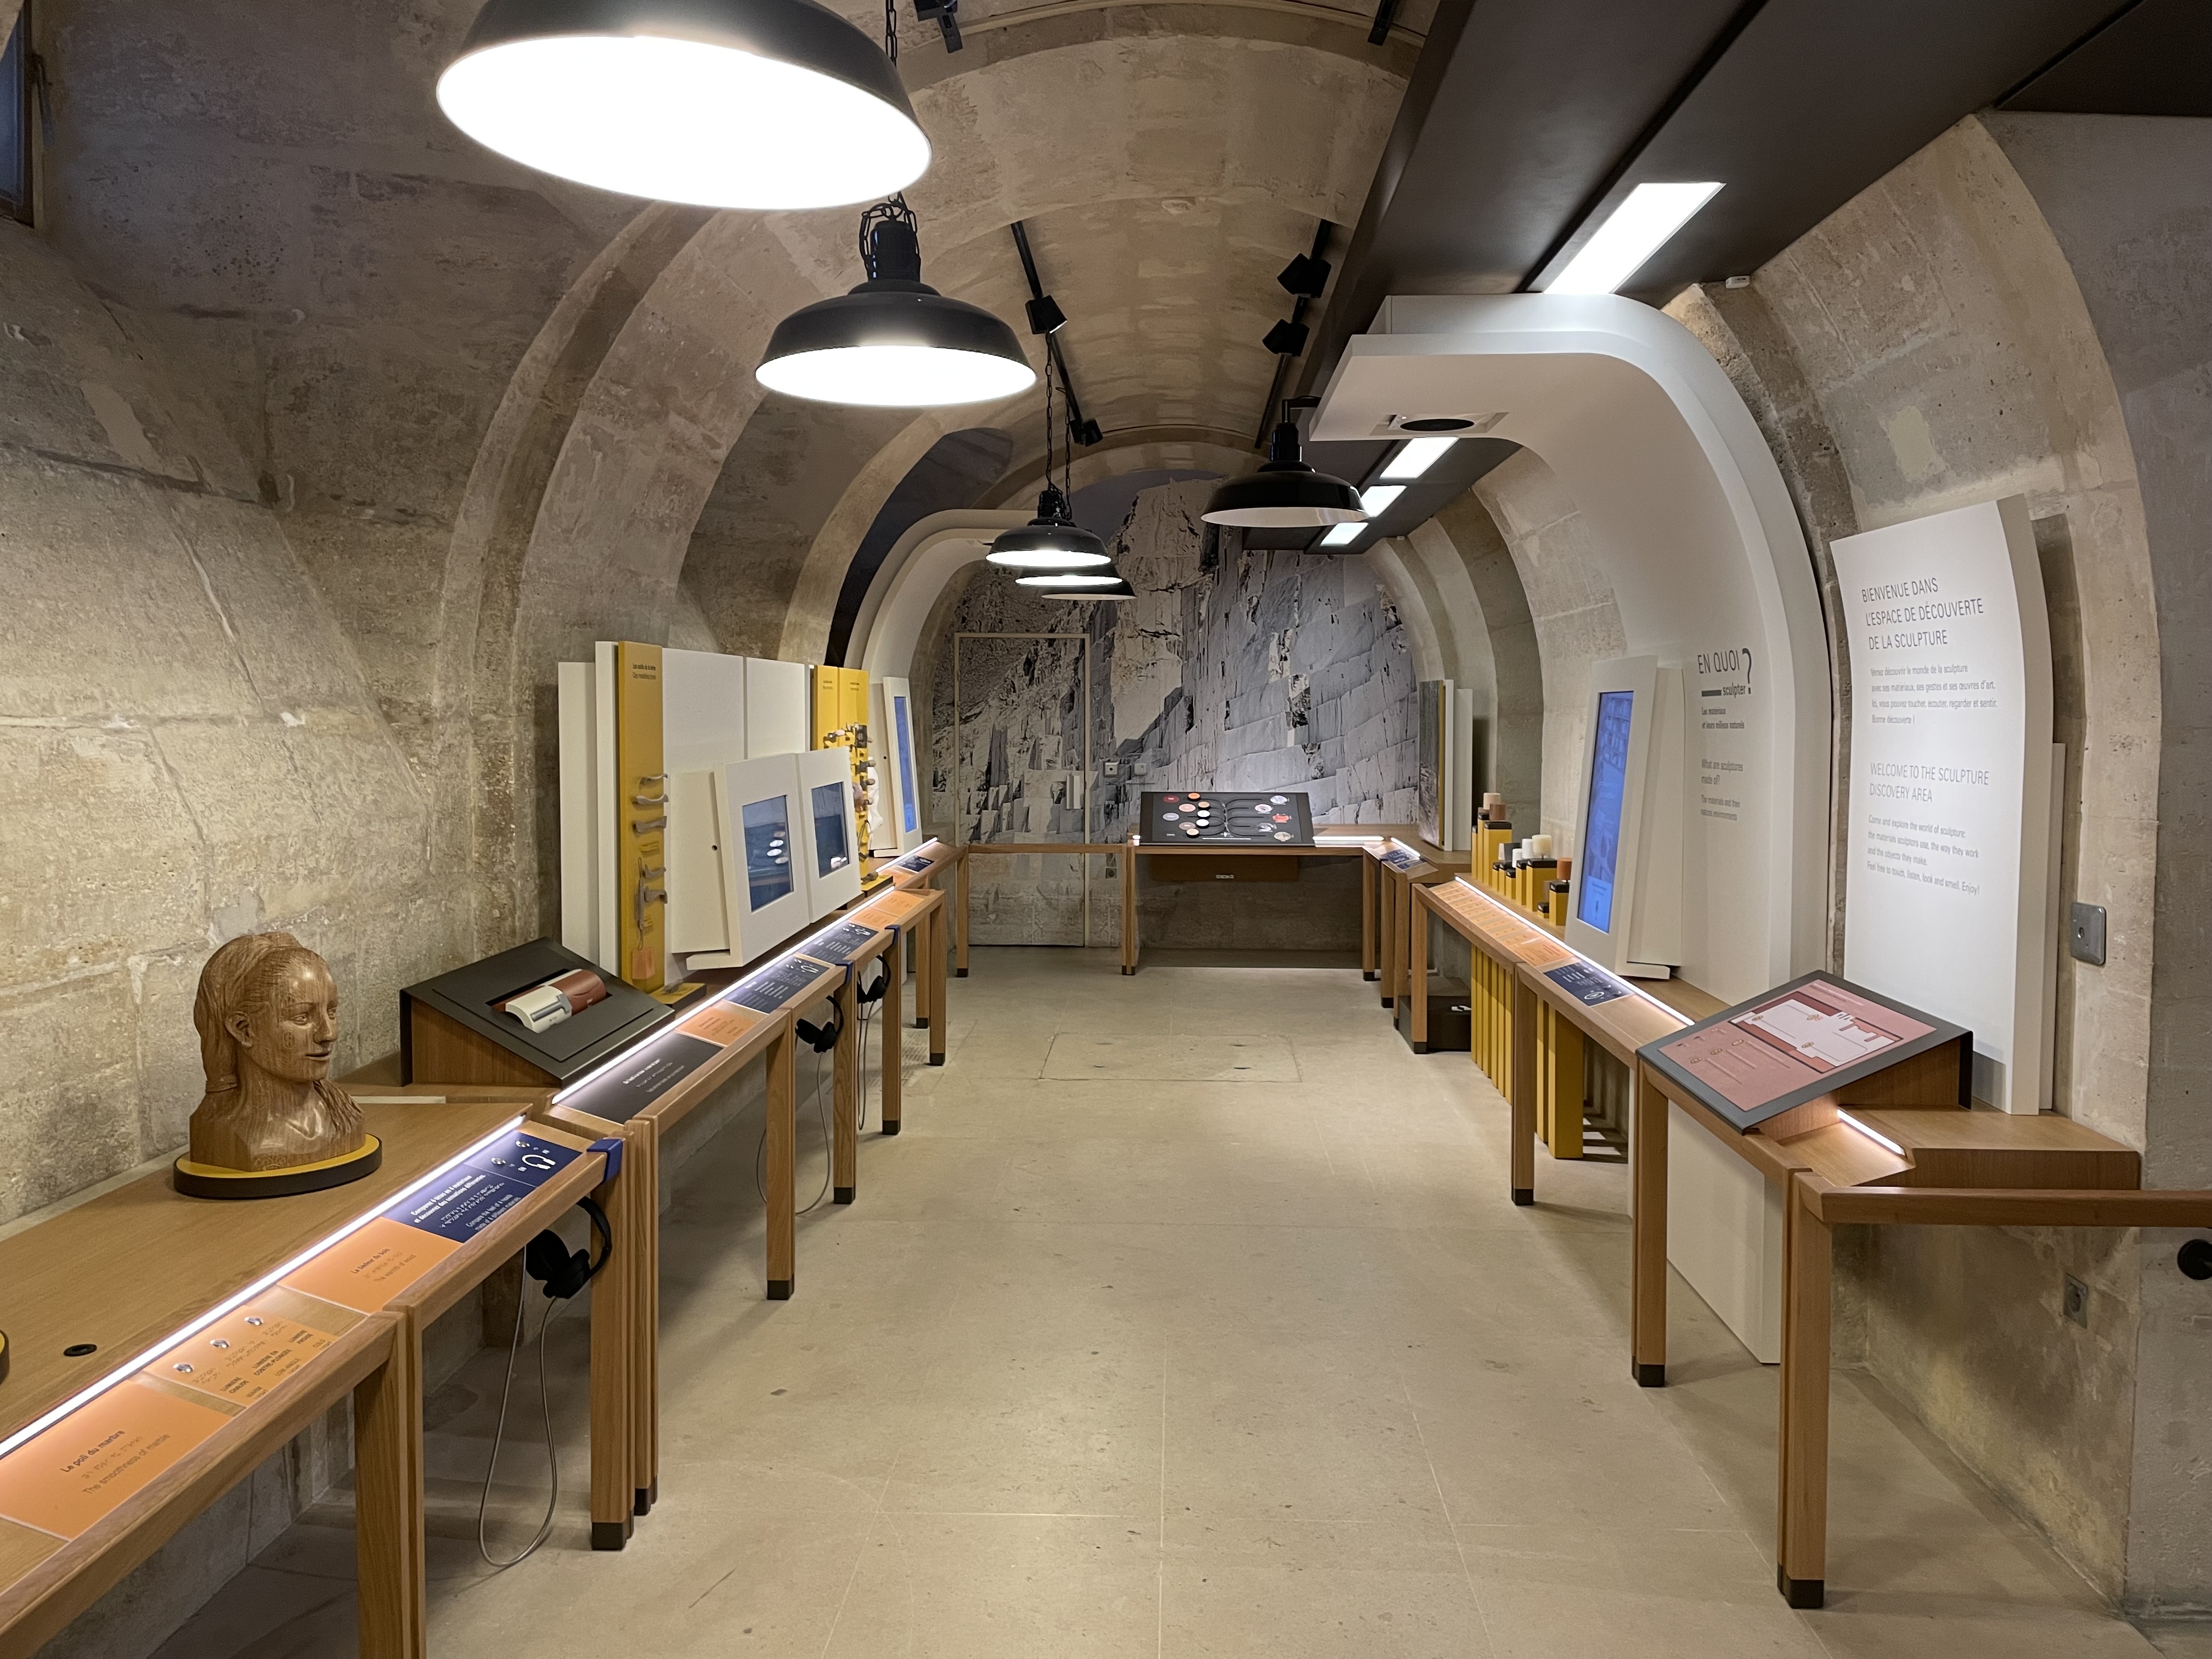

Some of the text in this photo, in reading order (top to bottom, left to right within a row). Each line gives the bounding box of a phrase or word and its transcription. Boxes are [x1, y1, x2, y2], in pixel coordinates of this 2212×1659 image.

[1862, 578, 1938, 602] BIENVENUE DANS
[1865, 598, 1984, 626] L'ESPACE DE DÉCOUVERTE
[1869, 630, 1948, 650] DE LA SCULPTURE
[1698, 654, 1711, 674] EN
[1713, 650, 1740, 673] QUOI
[1884, 666, 1906, 675] découvrir
[1906, 666, 1911, 674] le
[1912, 665, 1929, 674] monde
[1931, 664, 1937, 673] de
[1938, 664, 1942, 673] la
[1944, 664, 1968, 674] sculpture
[1723, 682, 1746, 698] sculpter
[1870, 763, 1989, 785] WELCOME TO THE SCULPTURE
[1870, 783, 1932, 802] DISCOVERY AREA
[1869, 815, 1881, 825] Come
[1892, 819, 1909, 829] explore
[1918, 823, 1933, 833] world
[1934, 825, 1939, 833] of
